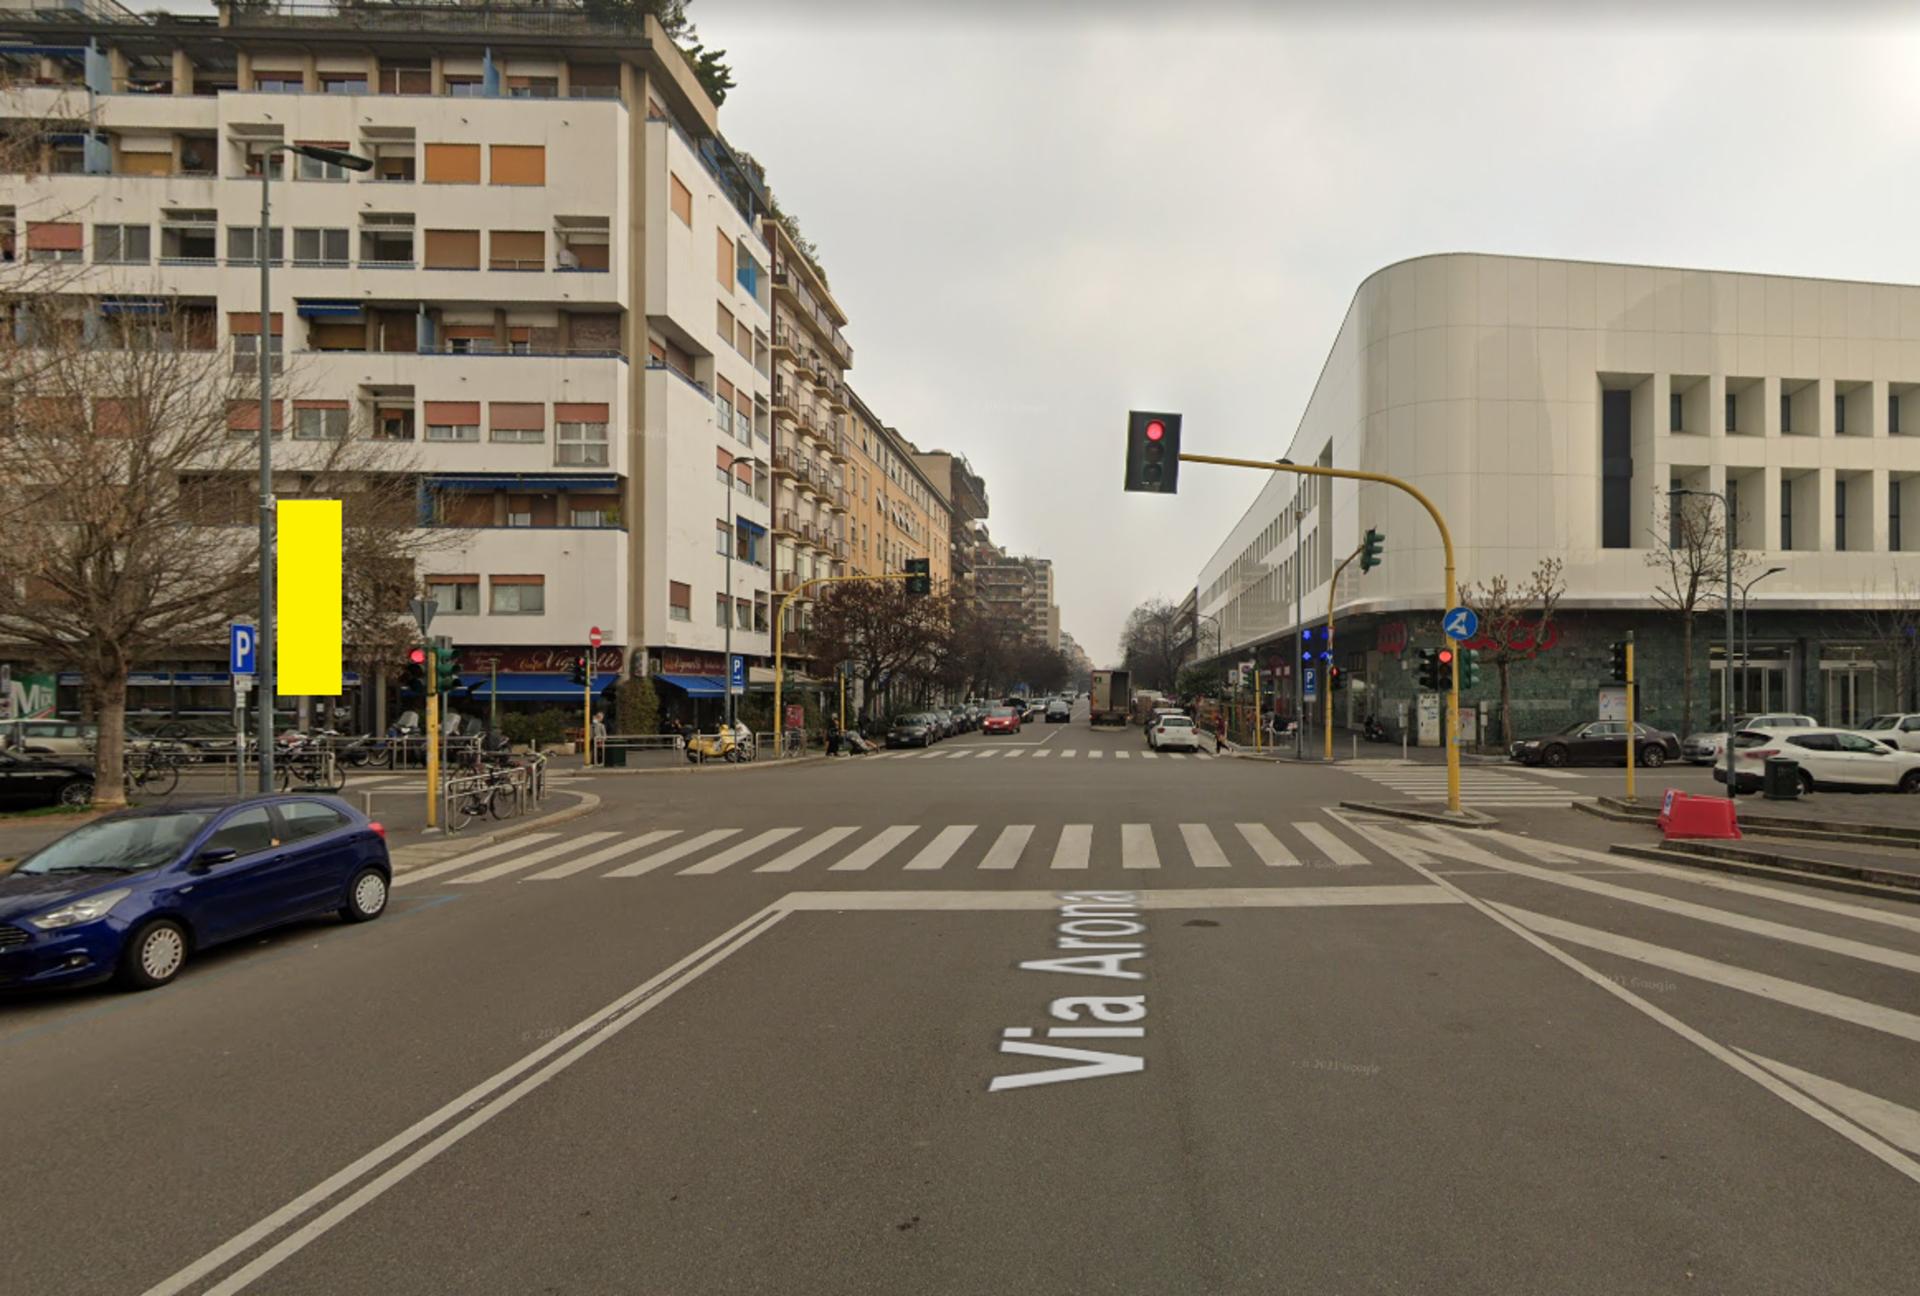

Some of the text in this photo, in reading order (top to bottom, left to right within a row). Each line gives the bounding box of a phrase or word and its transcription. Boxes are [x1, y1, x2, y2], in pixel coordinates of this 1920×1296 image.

[236, 630, 250, 668] P
[733, 659, 741, 673] P
[1306, 671, 1313, 683] P
